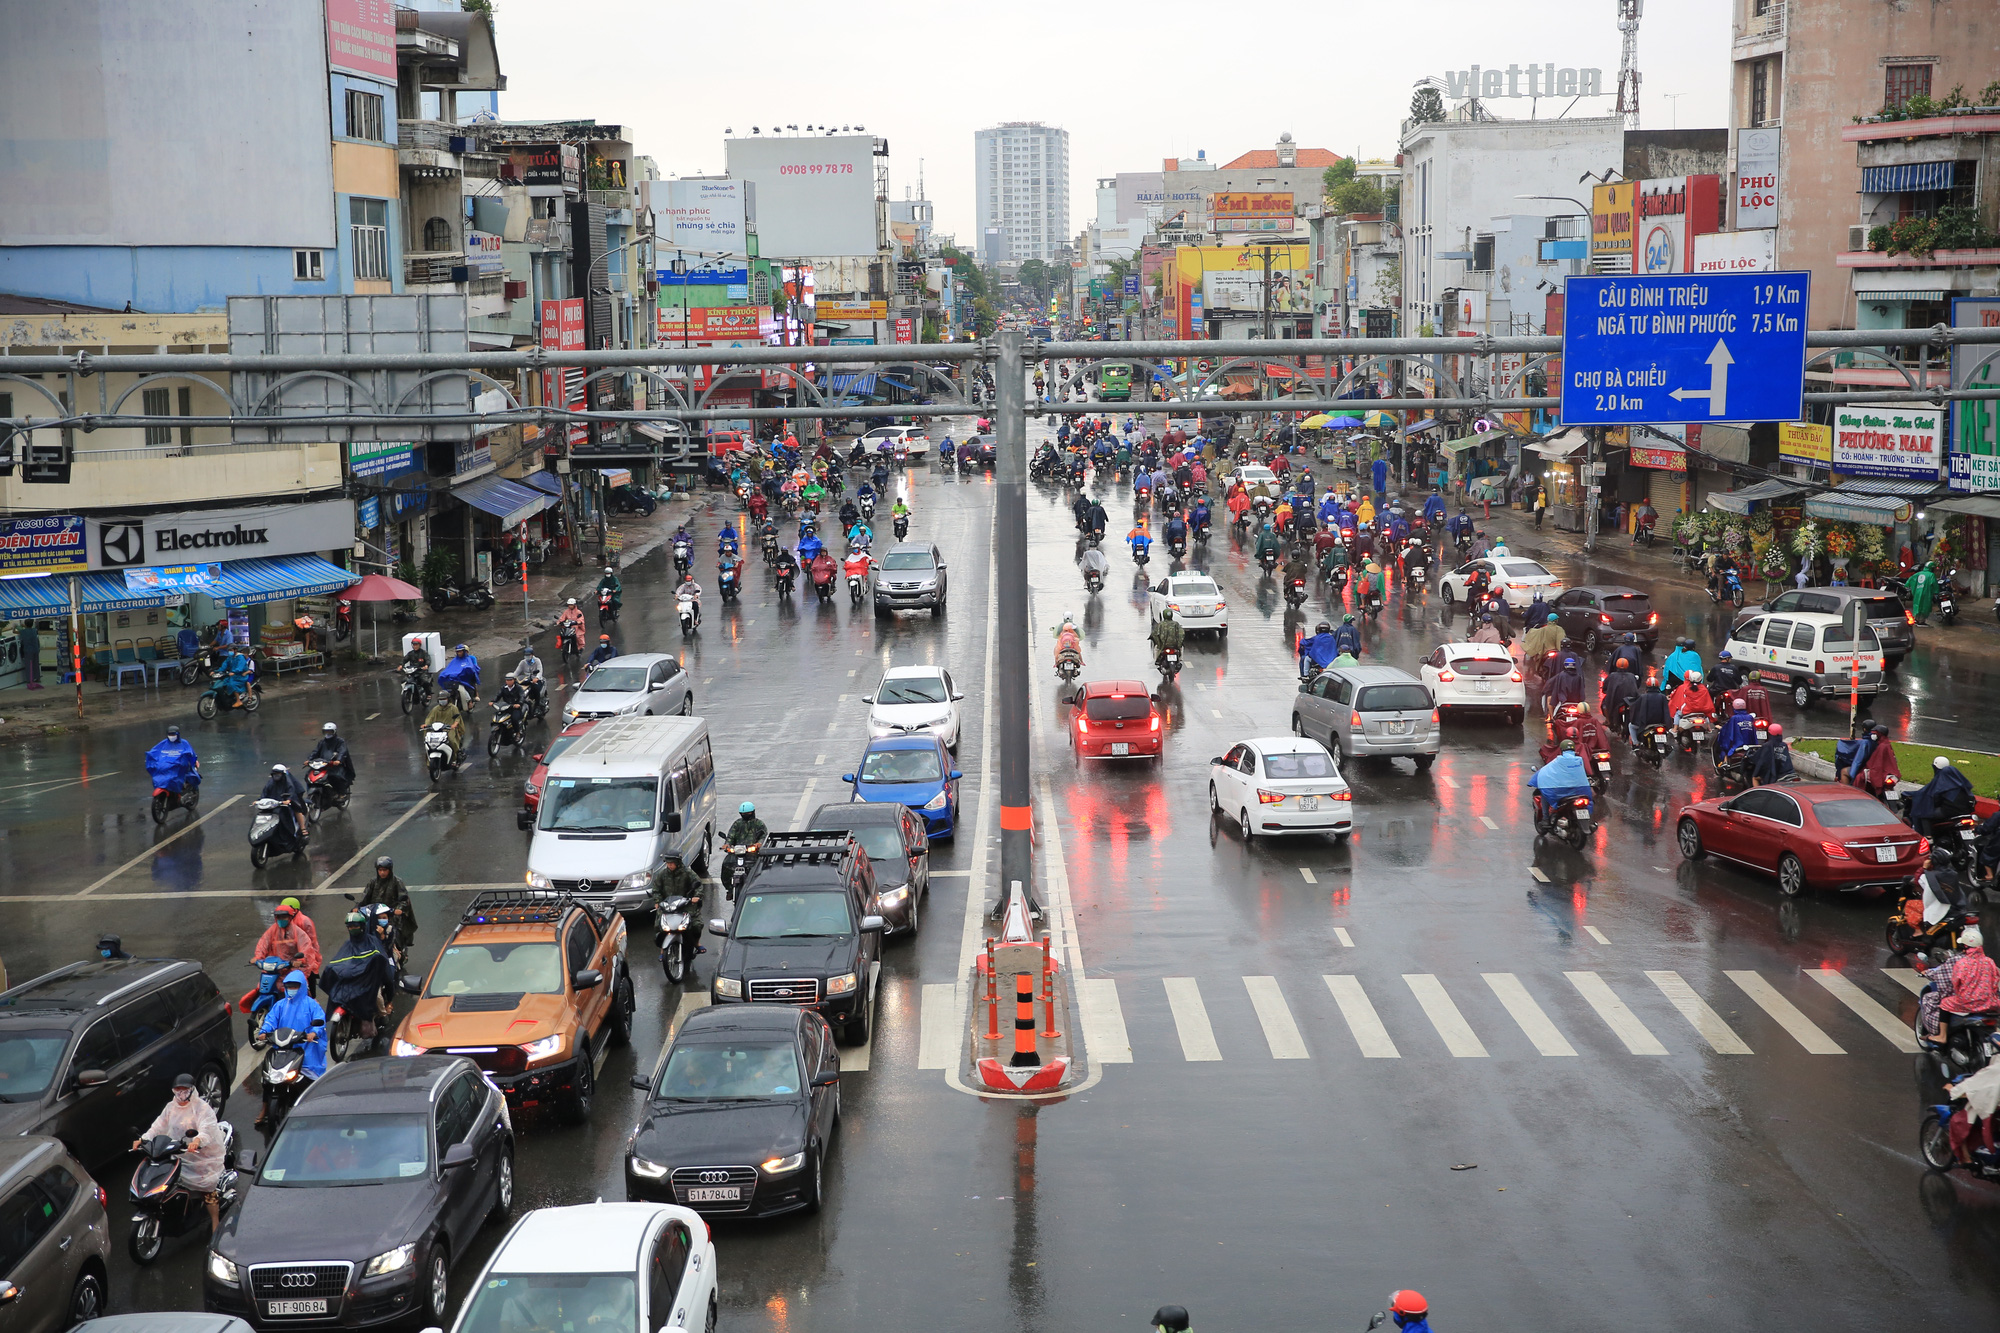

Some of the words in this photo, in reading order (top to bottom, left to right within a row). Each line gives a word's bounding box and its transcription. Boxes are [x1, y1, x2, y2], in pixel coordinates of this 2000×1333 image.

[1446, 63, 1600, 99] viettien
[528, 150, 559, 166] TUẤN
[780, 164, 807, 175] 0908
[809, 164, 822, 174] 99
[825, 164, 838, 174] 78
[840, 164, 853, 173] 78
[1740, 173, 1775, 188] PHÚ
[1137, 190, 1152, 200] HẢI
[1155, 191, 1164, 200] ÂU
[1252, 194, 1291, 210] HỒNG
[1741, 192, 1775, 209] LỘC
[677, 222, 703, 230] những
[1611, 212, 1630, 236] QUANG
[1701, 258, 1726, 271] PHÚ
[1731, 257, 1756, 270] LỘC
[1599, 282, 1626, 308] CẦU
[1630, 284, 1664, 307] BÌNH
[1668, 284, 1708, 309] TRIỆU
[1753, 285, 1773, 306] 1,9
[1778, 284, 1800, 304] Km
[546, 306, 556, 320] SỬA
[707, 307, 727, 315] KÍNH
[730, 307, 757, 315] THUỐC
[1370, 315, 1389, 326] MỸ
[1597, 313, 1626, 335] NGÃ
[1630, 315, 1648, 335] TƯ
[1652, 311, 1685, 334] BÌNH
[1689, 309, 1736, 334] PHƯỚC
[1752, 314, 1772, 334] 7,5
[1776, 314, 1798, 332] Km
[544, 325, 559, 339] CHỮA
[1574, 370, 1602, 390] CHỢ
[1605, 368, 1623, 387] BÀ
[1627, 363, 1666, 387] CHIỂU
[1595, 394, 1617, 412] 2,0
[1621, 394, 1643, 410] km
[1893, 416, 1912, 428] Hoa
[1914, 416, 1935, 430] Tươi
[1788, 430, 1809, 442] THUẬN
[1839, 430, 1895, 450] PHƯƠNG
[1899, 434, 1933, 452] NAM
[1841, 450, 1852, 460] CÓ:
[1854, 452, 1874, 461] HOÀNH
[1950, 454, 1969, 476] TIỆN
[1972, 459, 1986, 472] KÉT
[1972, 474, 1986, 487] KÉT
[15, 520, 43, 529] ACCU
[45, 519, 59, 528] GS
[34, 528, 80, 546] TUYẾN
[155, 524, 269, 551] Electrolux
[162, 577, 177, 587] 20
[184, 572, 209, 585] 40%
[230, 595, 245, 605] CỬA
[247, 592, 269, 603] HÀNG
[270, 589, 284, 600] ĐIỆN
[286, 586, 301, 597] MÁY
[303, 582, 345, 594] ELECTROLUX
[11, 607, 30, 618] CỬA
[32, 606, 57, 616] HÀNG
[84, 602, 104, 611] MÁY
[106, 598, 160, 609] ELECTROLUX
[690, 1190, 738, 1200] 51A-784.04
[270, 1302, 324, 1313] 51F-906.84
